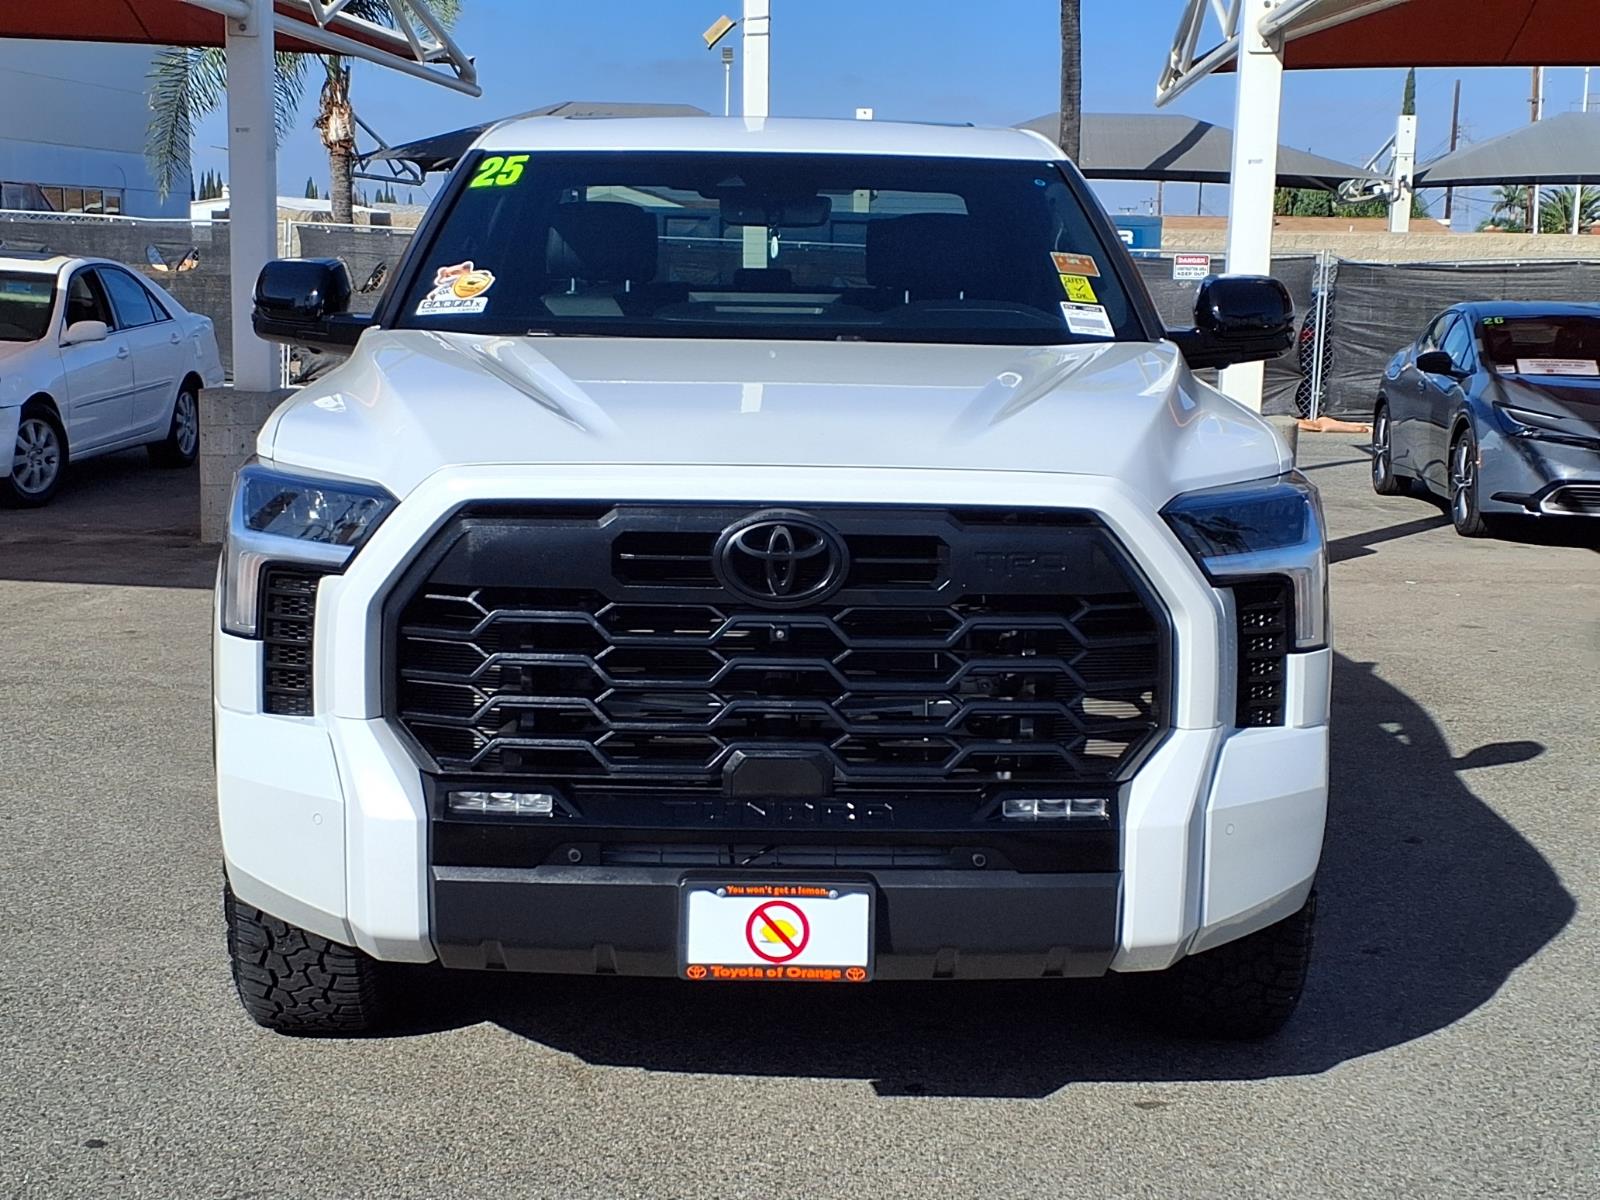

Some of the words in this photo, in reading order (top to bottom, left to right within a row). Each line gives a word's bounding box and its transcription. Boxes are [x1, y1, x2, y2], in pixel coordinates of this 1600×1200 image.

[470, 154, 530, 188] 25
[421, 300, 482, 309] CARFAX
[727, 885, 745, 895] You
[746, 885, 772, 895] won't
[773, 886, 789, 896] get
[790, 887, 797, 895] a
[710, 966, 764, 979] Toyota
[766, 966, 784, 978] of
[786, 966, 842, 980] Orange
